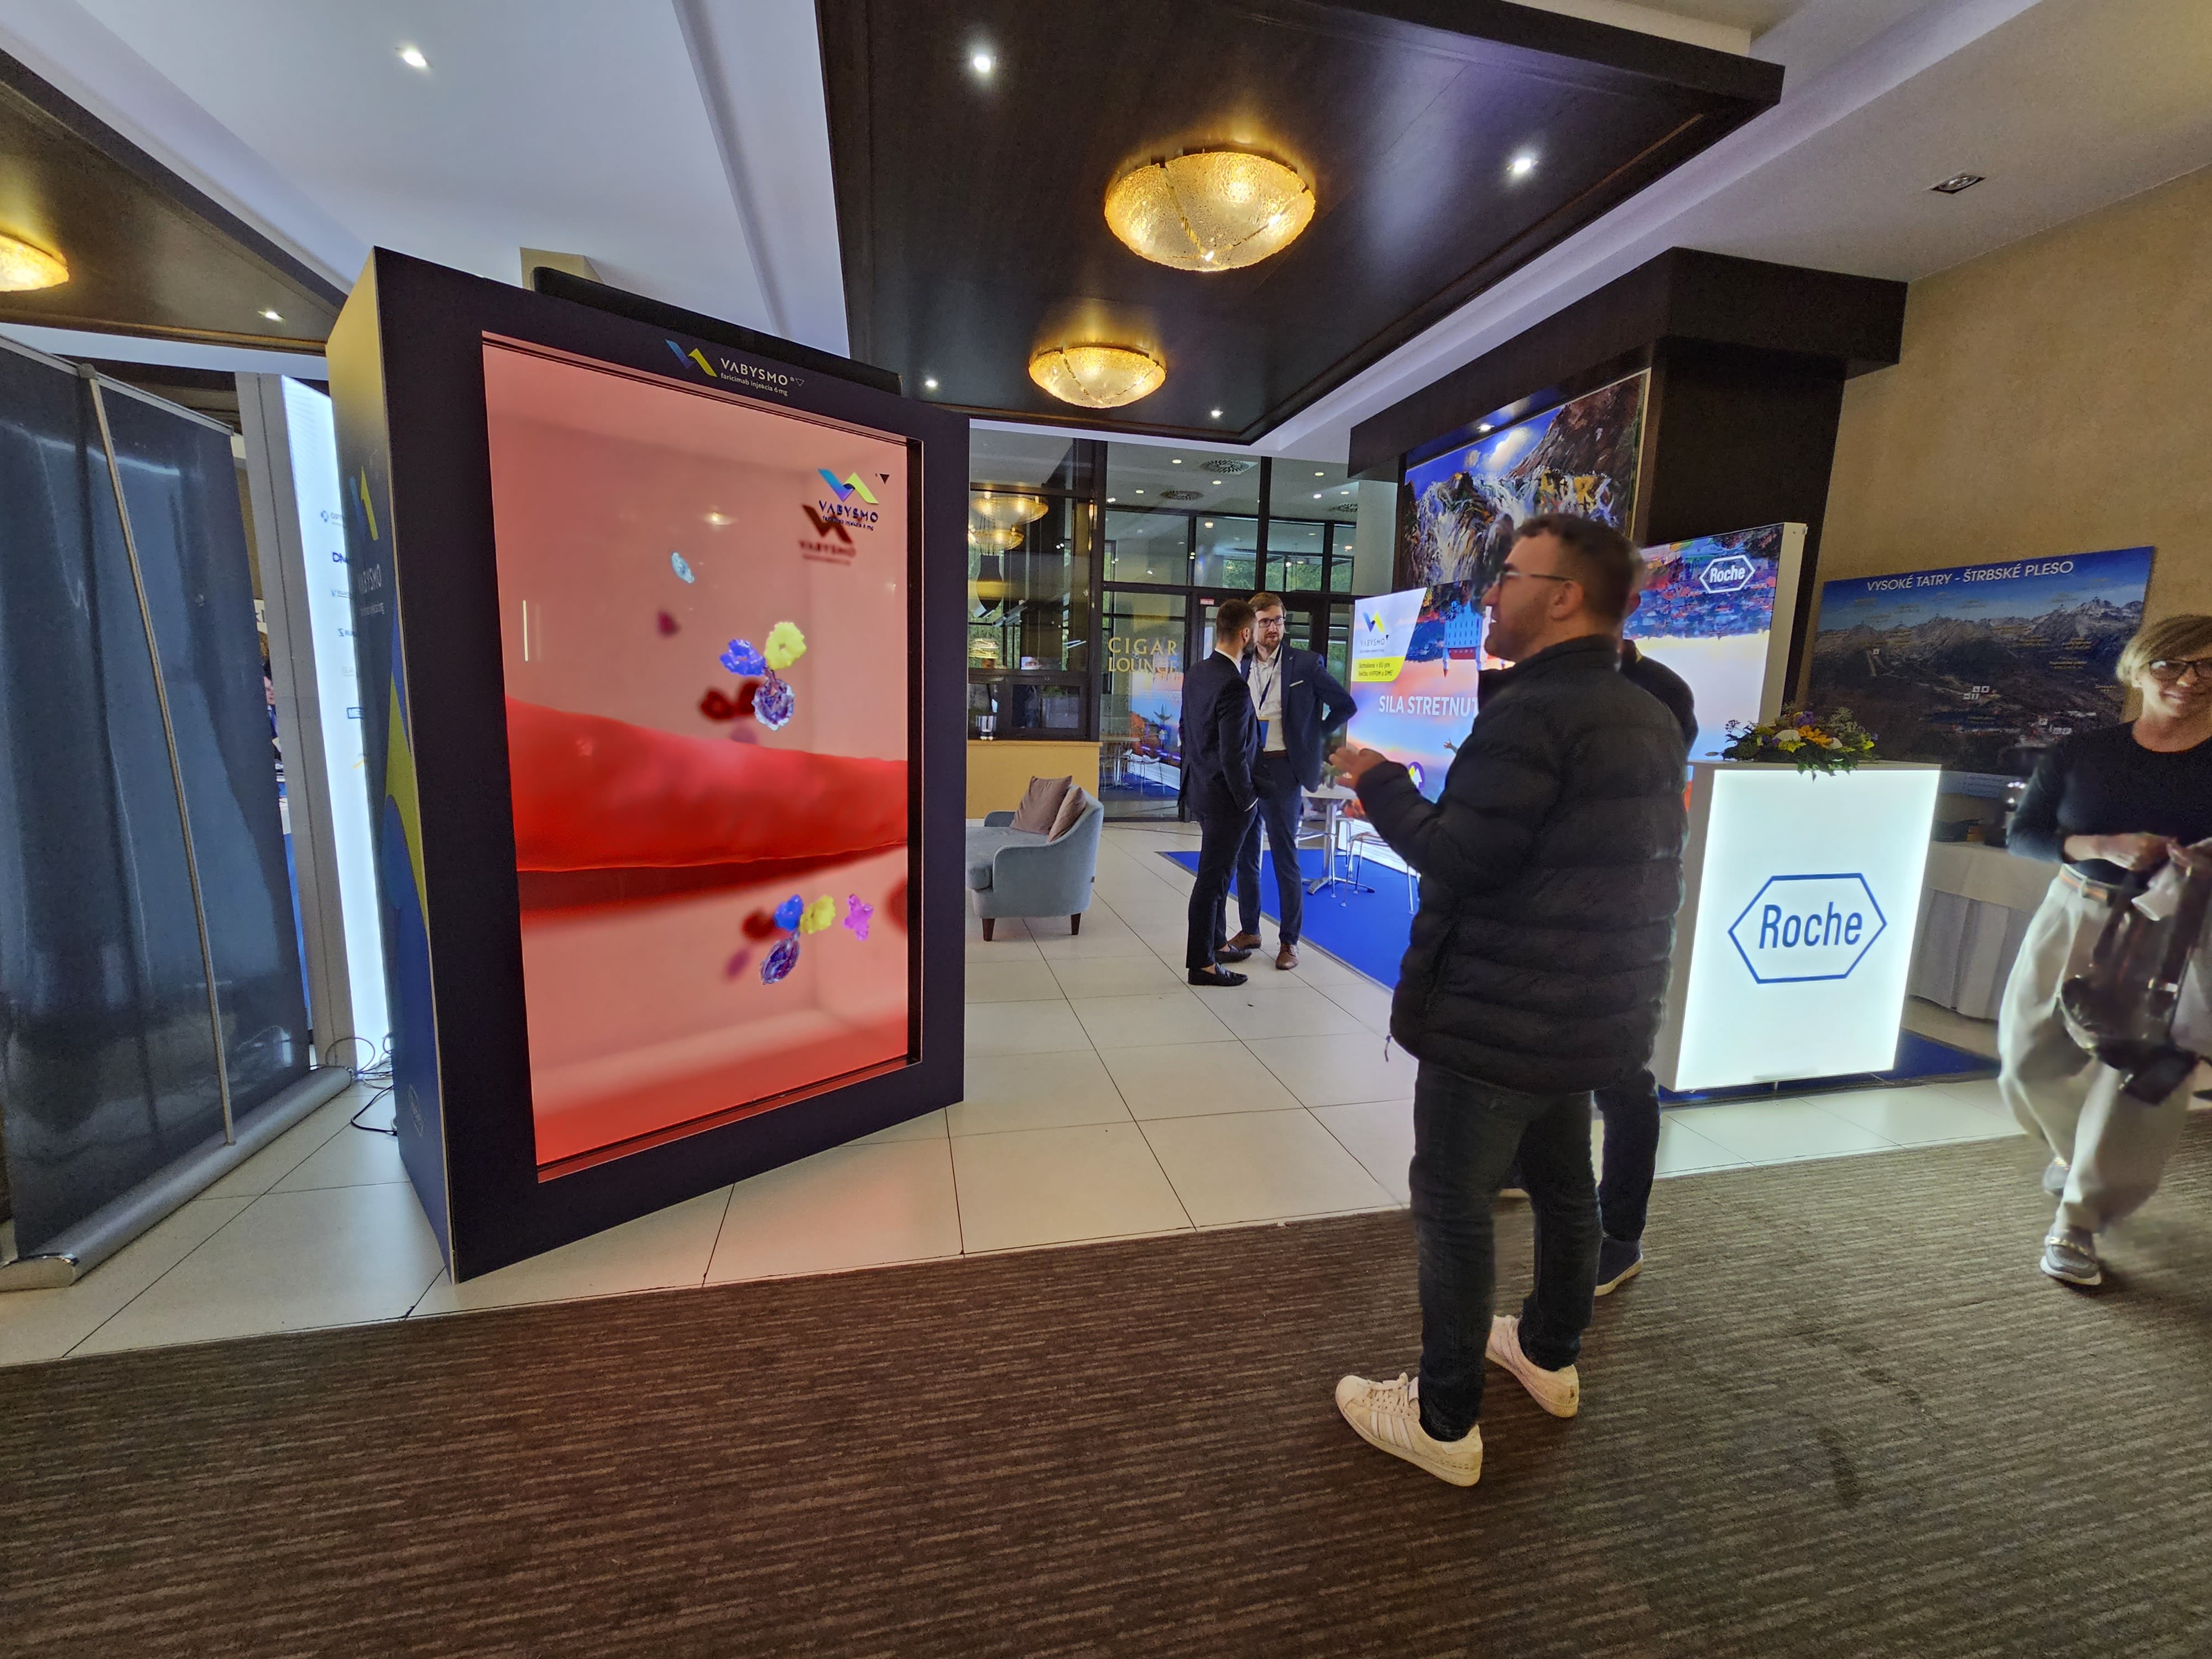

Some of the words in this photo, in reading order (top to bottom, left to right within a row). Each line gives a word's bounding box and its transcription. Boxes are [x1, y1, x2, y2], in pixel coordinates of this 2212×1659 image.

[720, 358, 788, 385] VABYSMO
[721, 372, 750, 385] faricimab
[750, 380, 773, 392] injekcia
[818, 499, 879, 523] VABYSMO
[1709, 565, 1746, 583] Roche
[1867, 575, 1914, 592] VYSOKÉ
[1916, 573, 1953, 588] TATRY
[1963, 563, 2022, 583] ŠTRBSKÉ
[2025, 560, 2074, 577] PLESO
[1108, 637, 1177, 656] CIGAR
[1360, 638, 1385, 646] VABYSMO
[1378, 695, 1405, 714] SILA
[1759, 901, 1863, 950] Roche
